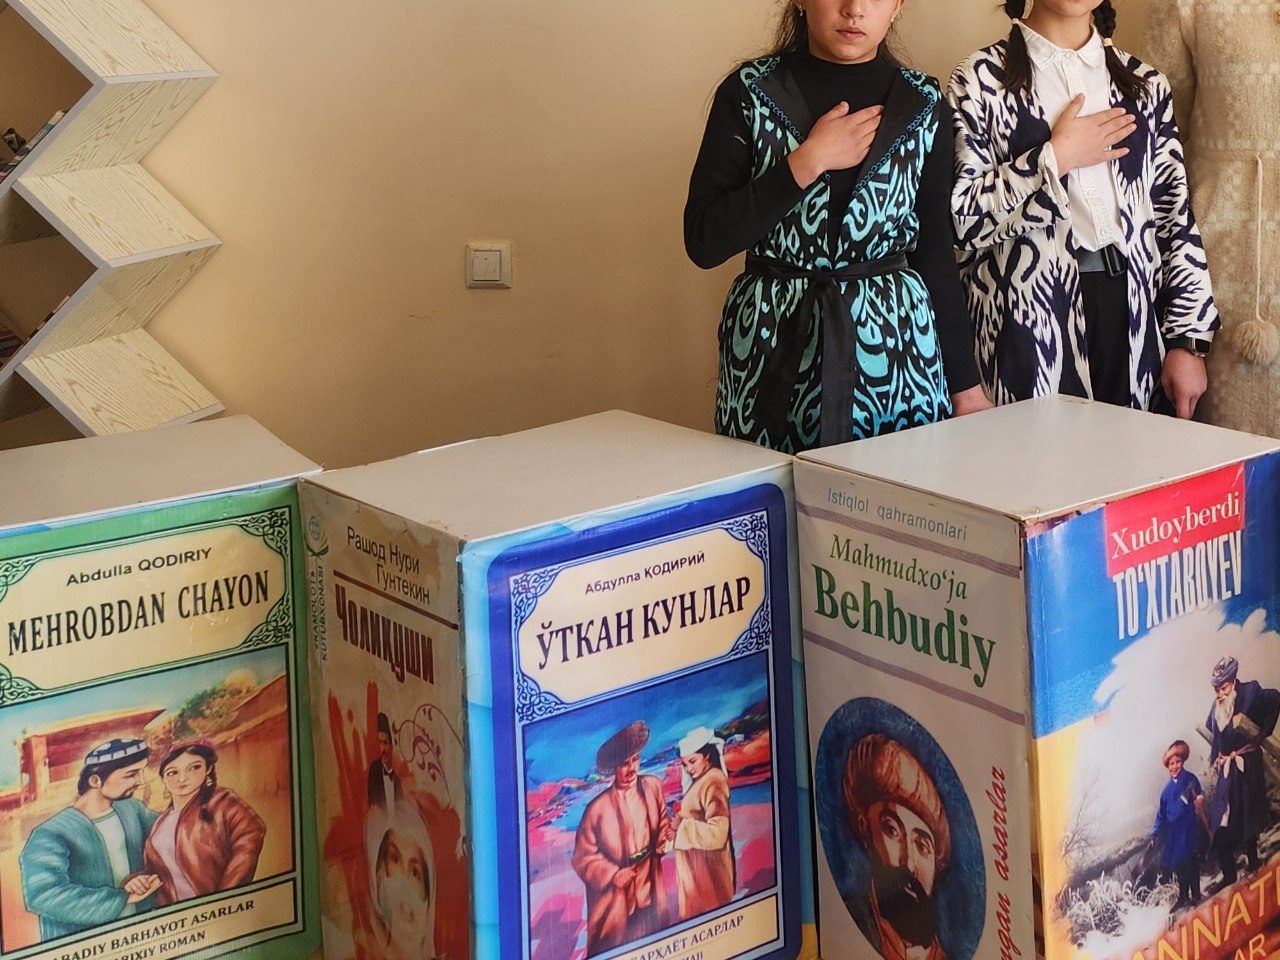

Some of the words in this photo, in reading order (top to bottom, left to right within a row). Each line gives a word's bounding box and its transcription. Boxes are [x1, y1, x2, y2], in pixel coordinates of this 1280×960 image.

[828, 488, 869, 512] Istiqlol
[877, 506, 967, 541] qahramonlari
[1110, 491, 1241, 560] Xudoyberdi
[66, 564, 132, 586] Abdulla
[138, 547, 213, 572] QODIRIY
[347, 526, 386, 562] Рашод
[390, 542, 420, 575] Нури
[585, 572, 641, 595] Абдулла
[644, 550, 706, 581] ҚОДИРИЙ
[377, 563, 430, 605] Гунтекин
[8, 592, 166, 656] MEHROBDAN
[178, 570, 269, 619] CHAYON
[536, 608, 634, 670] ЎТКАН
[642, 576, 751, 640] КУНЛАР
[812, 564, 996, 688] Behbudiy
[985, 766, 1009, 881] asarlar
[111, 917, 188, 950] BARHAYOT
[191, 901, 255, 926] ASARLAR
[160, 931, 206, 953] ROMAN
[690, 915, 744, 946] АСАРЛАР
